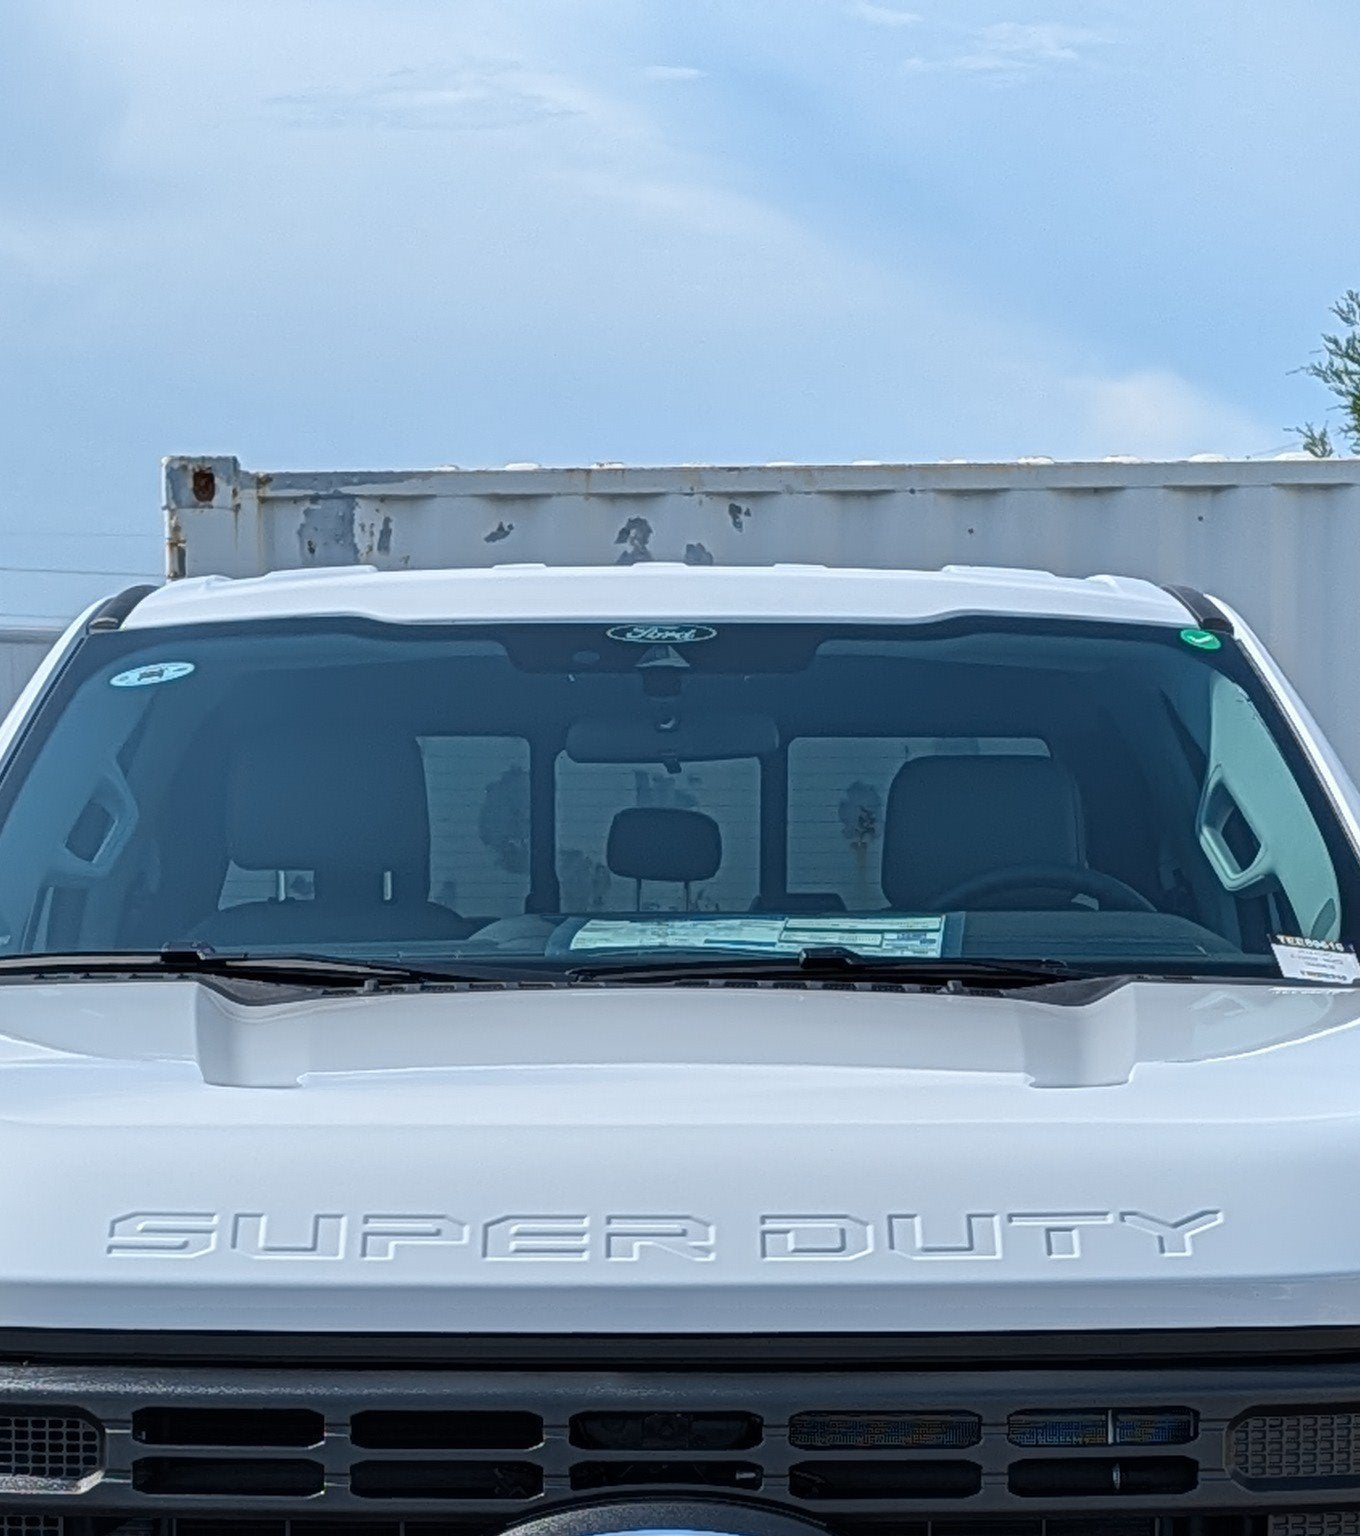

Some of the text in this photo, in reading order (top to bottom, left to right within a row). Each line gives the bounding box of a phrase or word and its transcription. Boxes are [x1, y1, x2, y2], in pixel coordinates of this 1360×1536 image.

[626, 626, 696, 640] Ford
[107, 1209, 1225, 1261] SUPER DUTY
